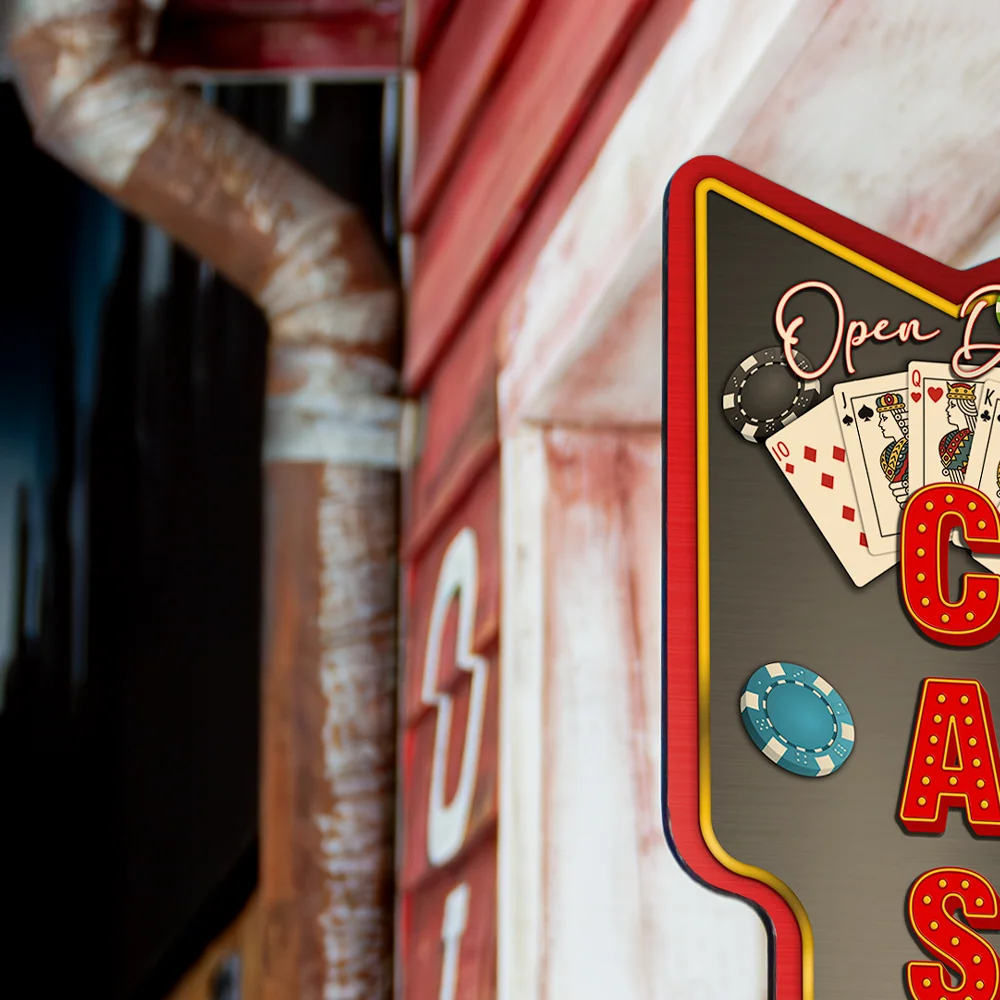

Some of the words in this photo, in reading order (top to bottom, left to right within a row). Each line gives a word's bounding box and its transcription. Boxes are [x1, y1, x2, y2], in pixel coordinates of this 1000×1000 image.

[774, 280, 940, 380] Open
[984, 388, 996, 407] K
[771, 441, 790, 462] 10
